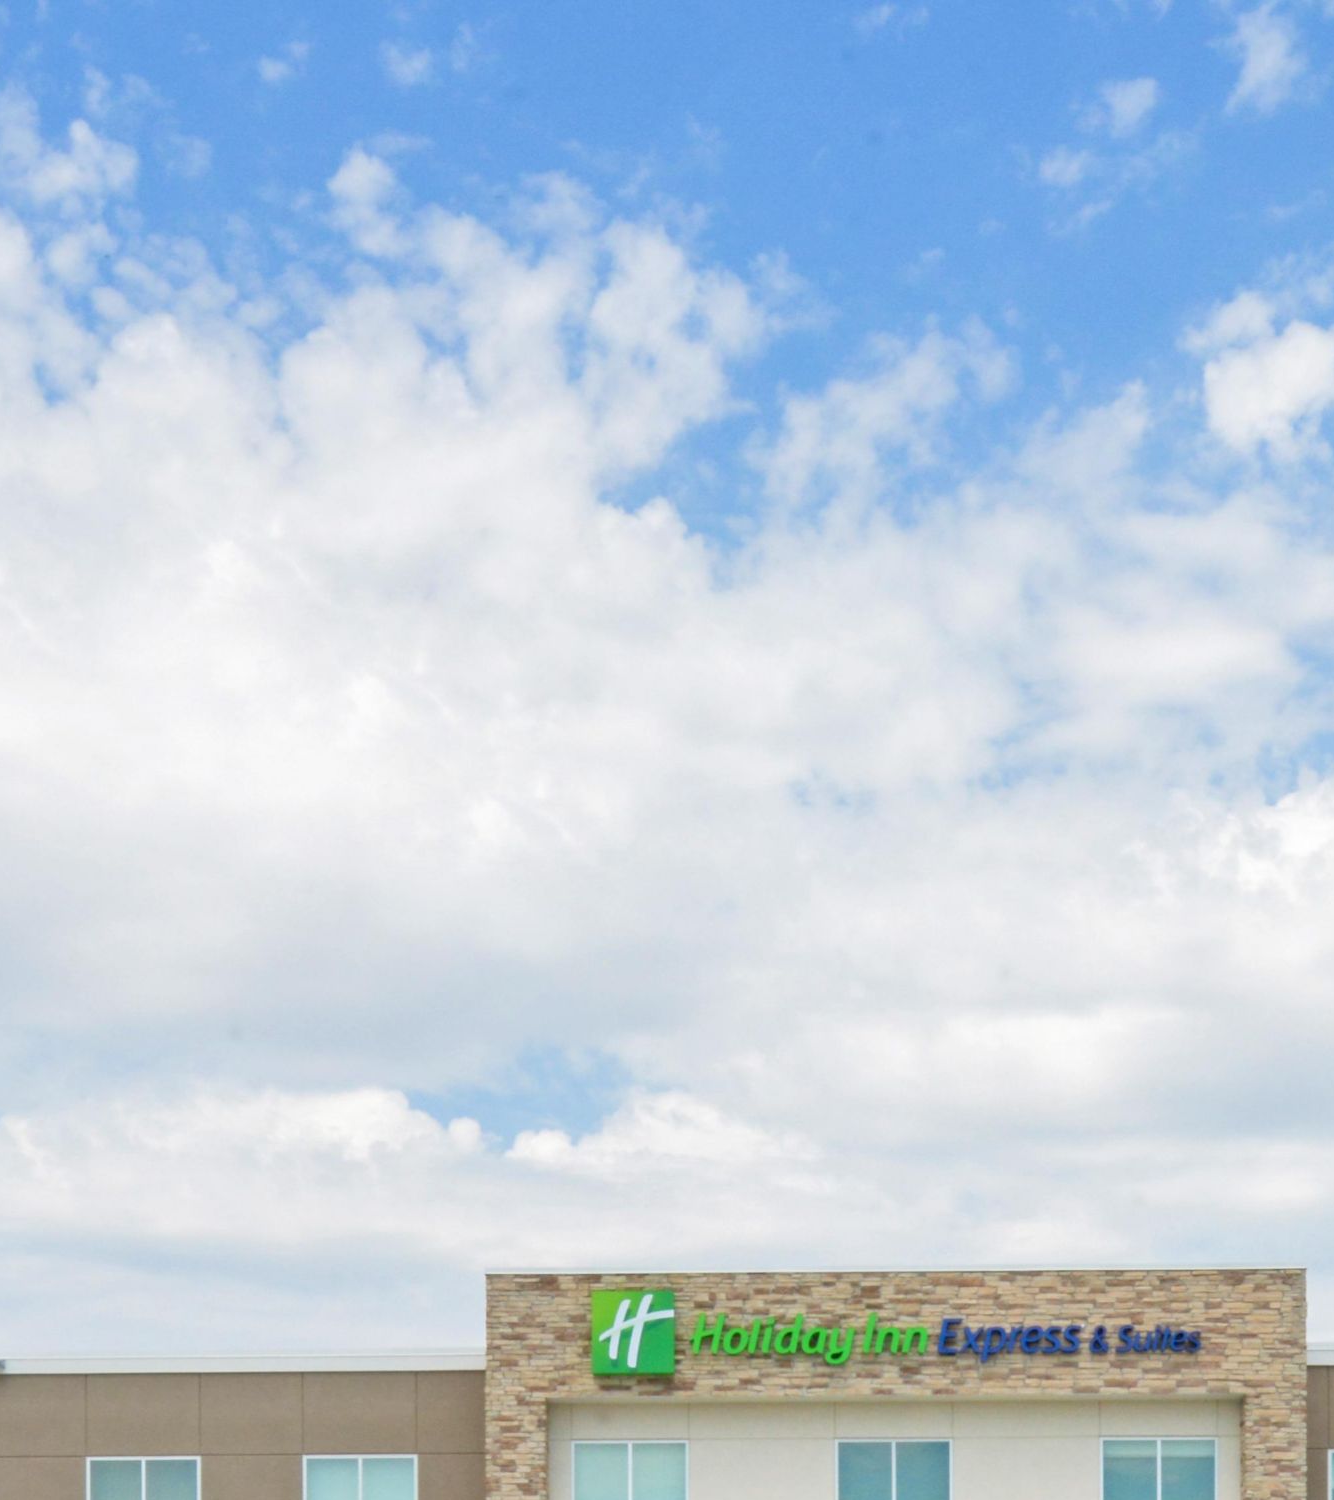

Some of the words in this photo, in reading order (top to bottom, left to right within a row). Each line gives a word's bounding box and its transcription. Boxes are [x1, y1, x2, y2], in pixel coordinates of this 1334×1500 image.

[691, 1312, 855, 1365] Holiday
[862, 1312, 929, 1355] Inn
[937, 1317, 1083, 1363] Express
[1088, 1325, 1110, 1354] &
[1116, 1324, 1203, 1354] Suites
